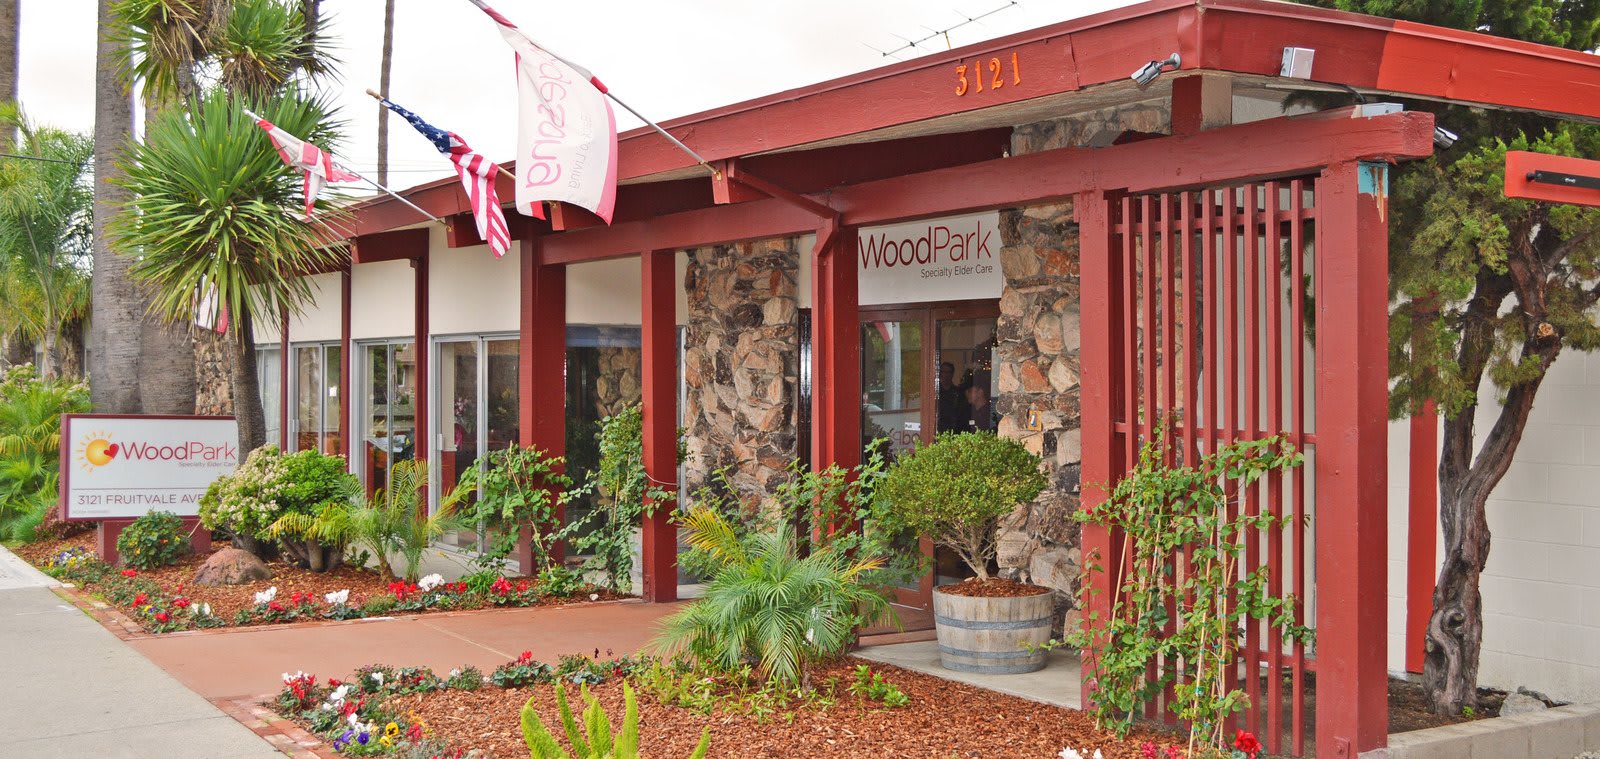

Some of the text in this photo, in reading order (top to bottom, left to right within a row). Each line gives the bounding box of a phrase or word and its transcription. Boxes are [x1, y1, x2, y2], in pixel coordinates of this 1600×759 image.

[955, 52, 1021, 96] 3121
[858, 220, 992, 269] WoodPark
[920, 264, 993, 278] Specialty Elder Care
[121, 441, 236, 460] WoodPark
[78, 494, 205, 505] 3121 FRUITVALE AVE
